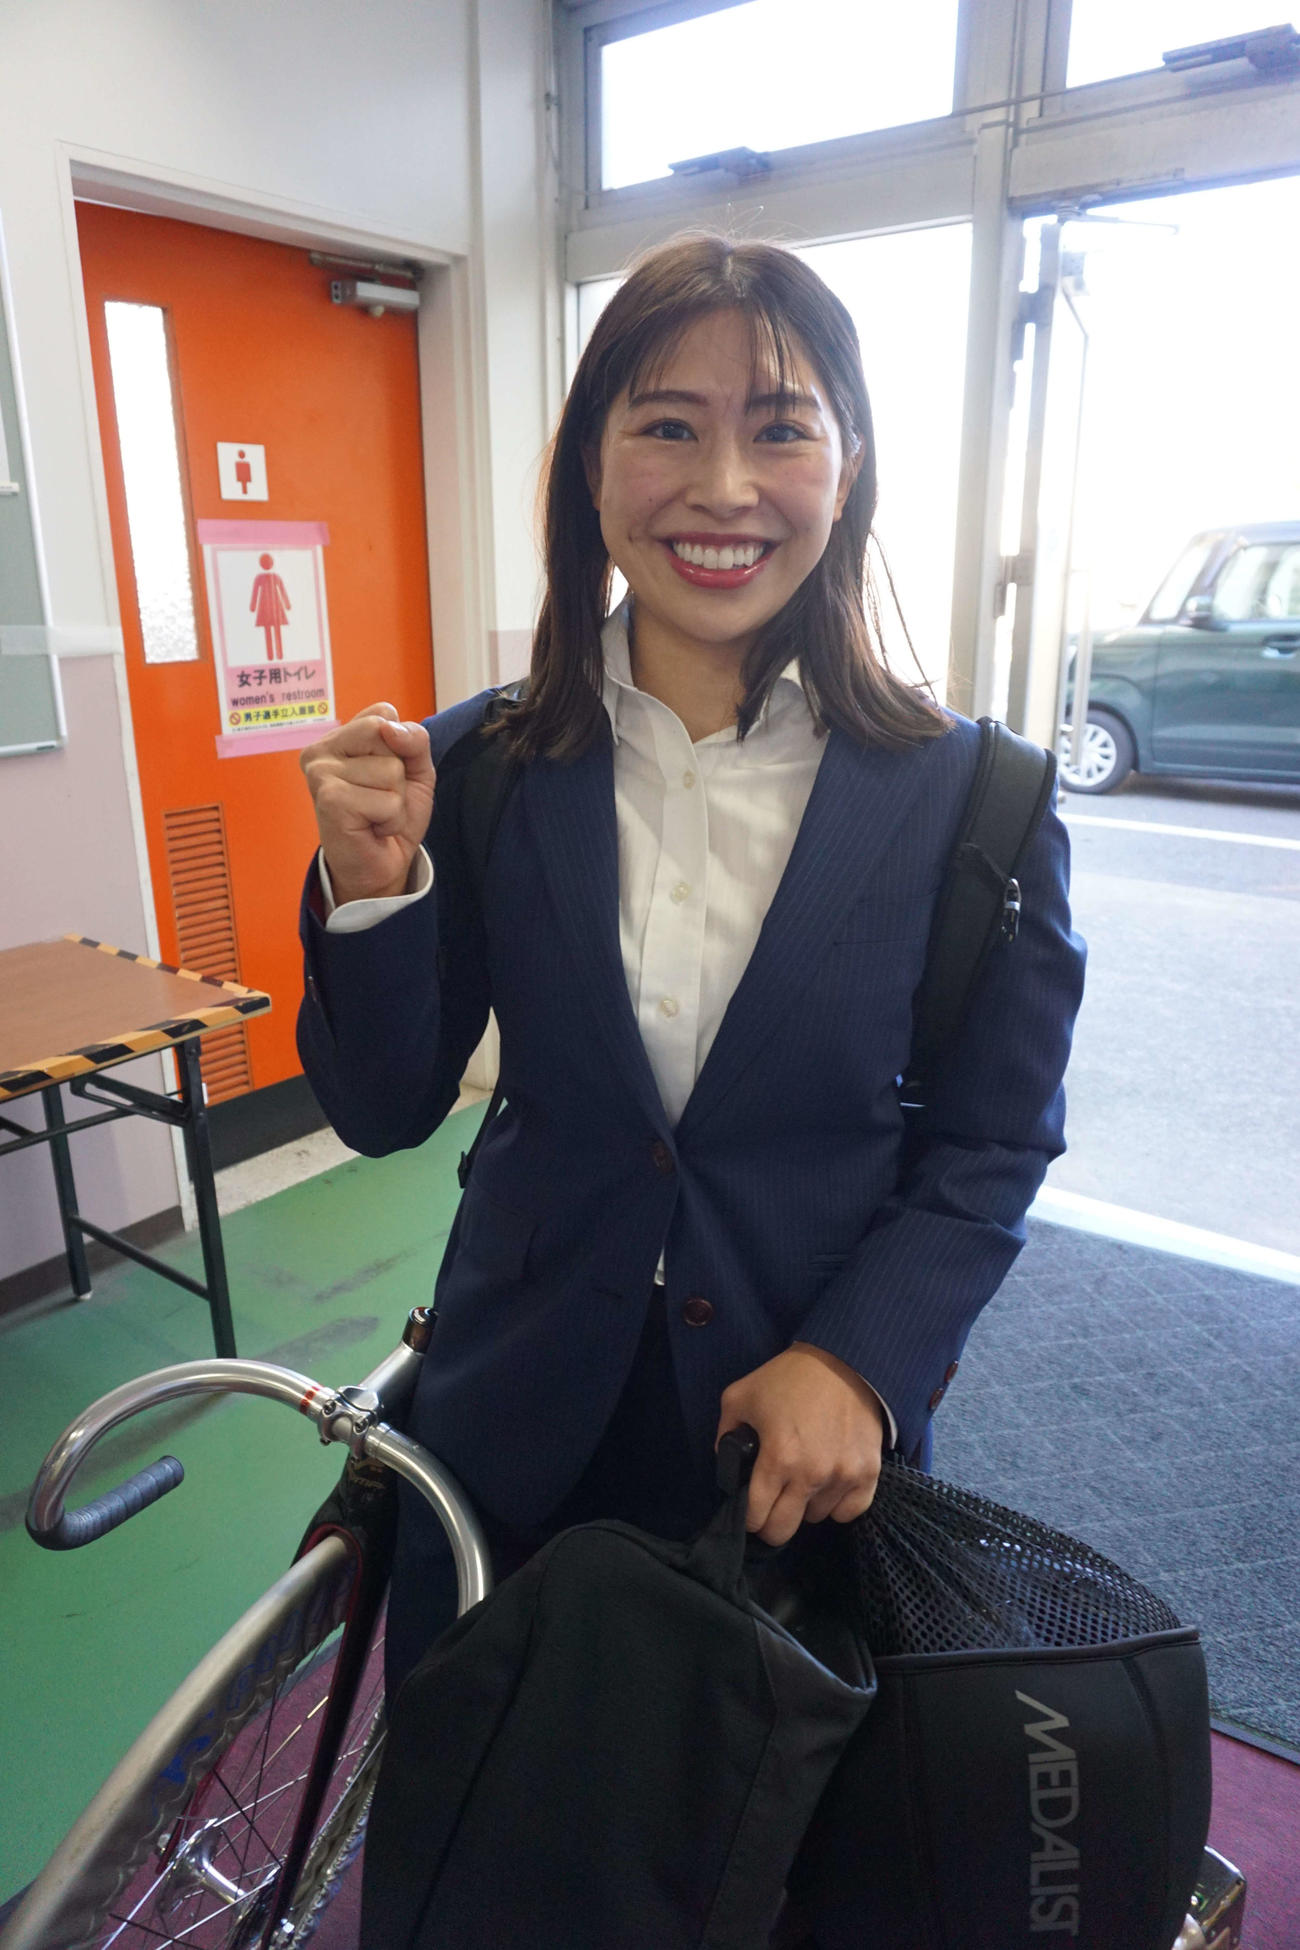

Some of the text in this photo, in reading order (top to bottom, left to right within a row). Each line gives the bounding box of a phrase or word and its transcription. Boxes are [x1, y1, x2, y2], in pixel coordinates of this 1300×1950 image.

[237, 665, 315, 687] 女子用トイレ
[231, 688, 325, 707] women's restroom
[1015, 1690, 1080, 1936] MEDALIST
